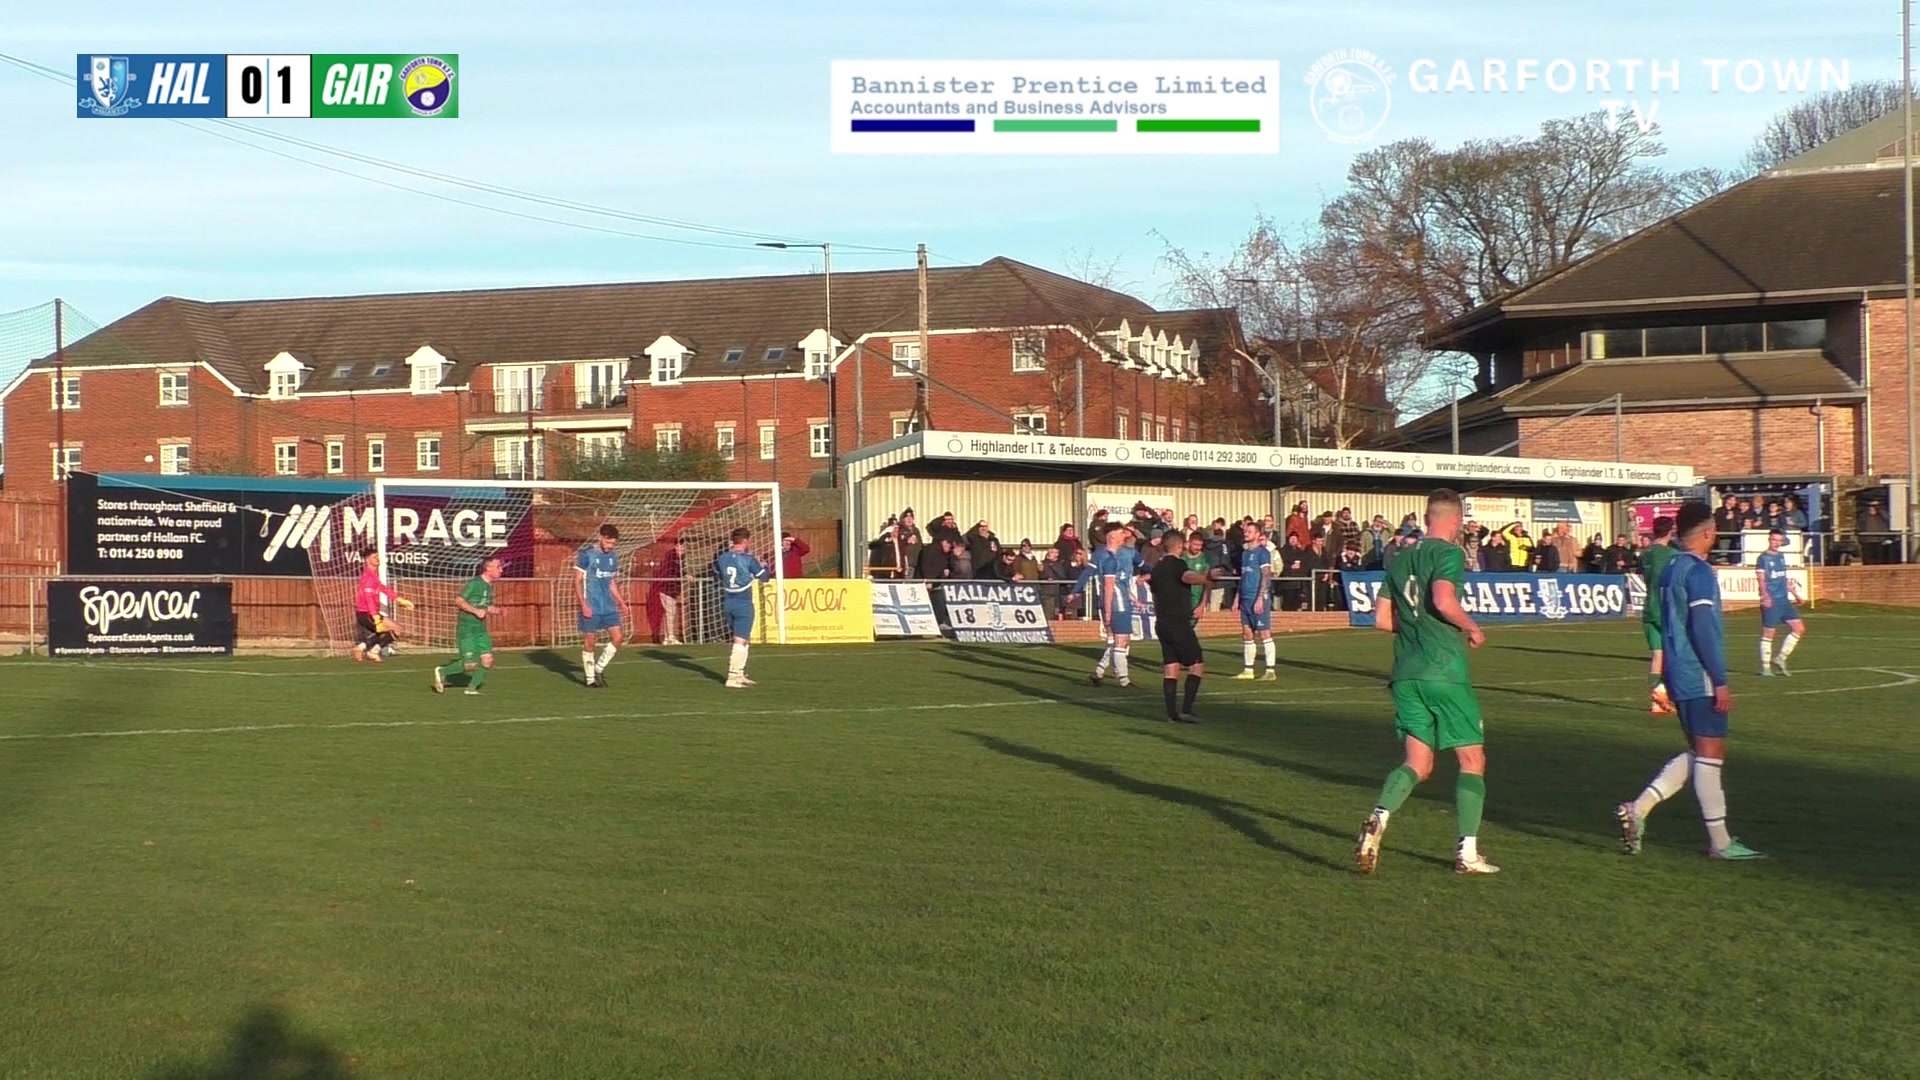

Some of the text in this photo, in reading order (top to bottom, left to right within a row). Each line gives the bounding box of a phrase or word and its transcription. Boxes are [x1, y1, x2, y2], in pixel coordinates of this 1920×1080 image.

[970, 439, 1107, 457] Highlander I.T. & Telecoms
[1140, 446, 1257, 464] Telephone 0114 292 3800
[1289, 453, 1339, 469] Highlander
[1356, 456, 1363, 469] &
[1365, 457, 1406, 471] Telecoms
[1435, 460, 1531, 476] www.highlanderuk.com
[1560, 465, 1603, 480] Highlander
[1618, 469, 1625, 480] &
[1625, 468, 1661, 482] Telecoms
[97, 498, 237, 514] Stores throughout Sheffield &
[97, 515, 222, 530] nationwide. We are proud
[97, 531, 206, 544] partners of Hallam FC.
[97, 547, 184, 560] T: 0114 250 8908
[344, 551, 367, 564] VA
[943, 584, 1036, 603] HALLAM FC
[1564, 583, 1624, 614] 1860
[954, 608, 1037, 624] 18 60
[87, 633, 195, 644] SpencersEstateAgents.co.uk
